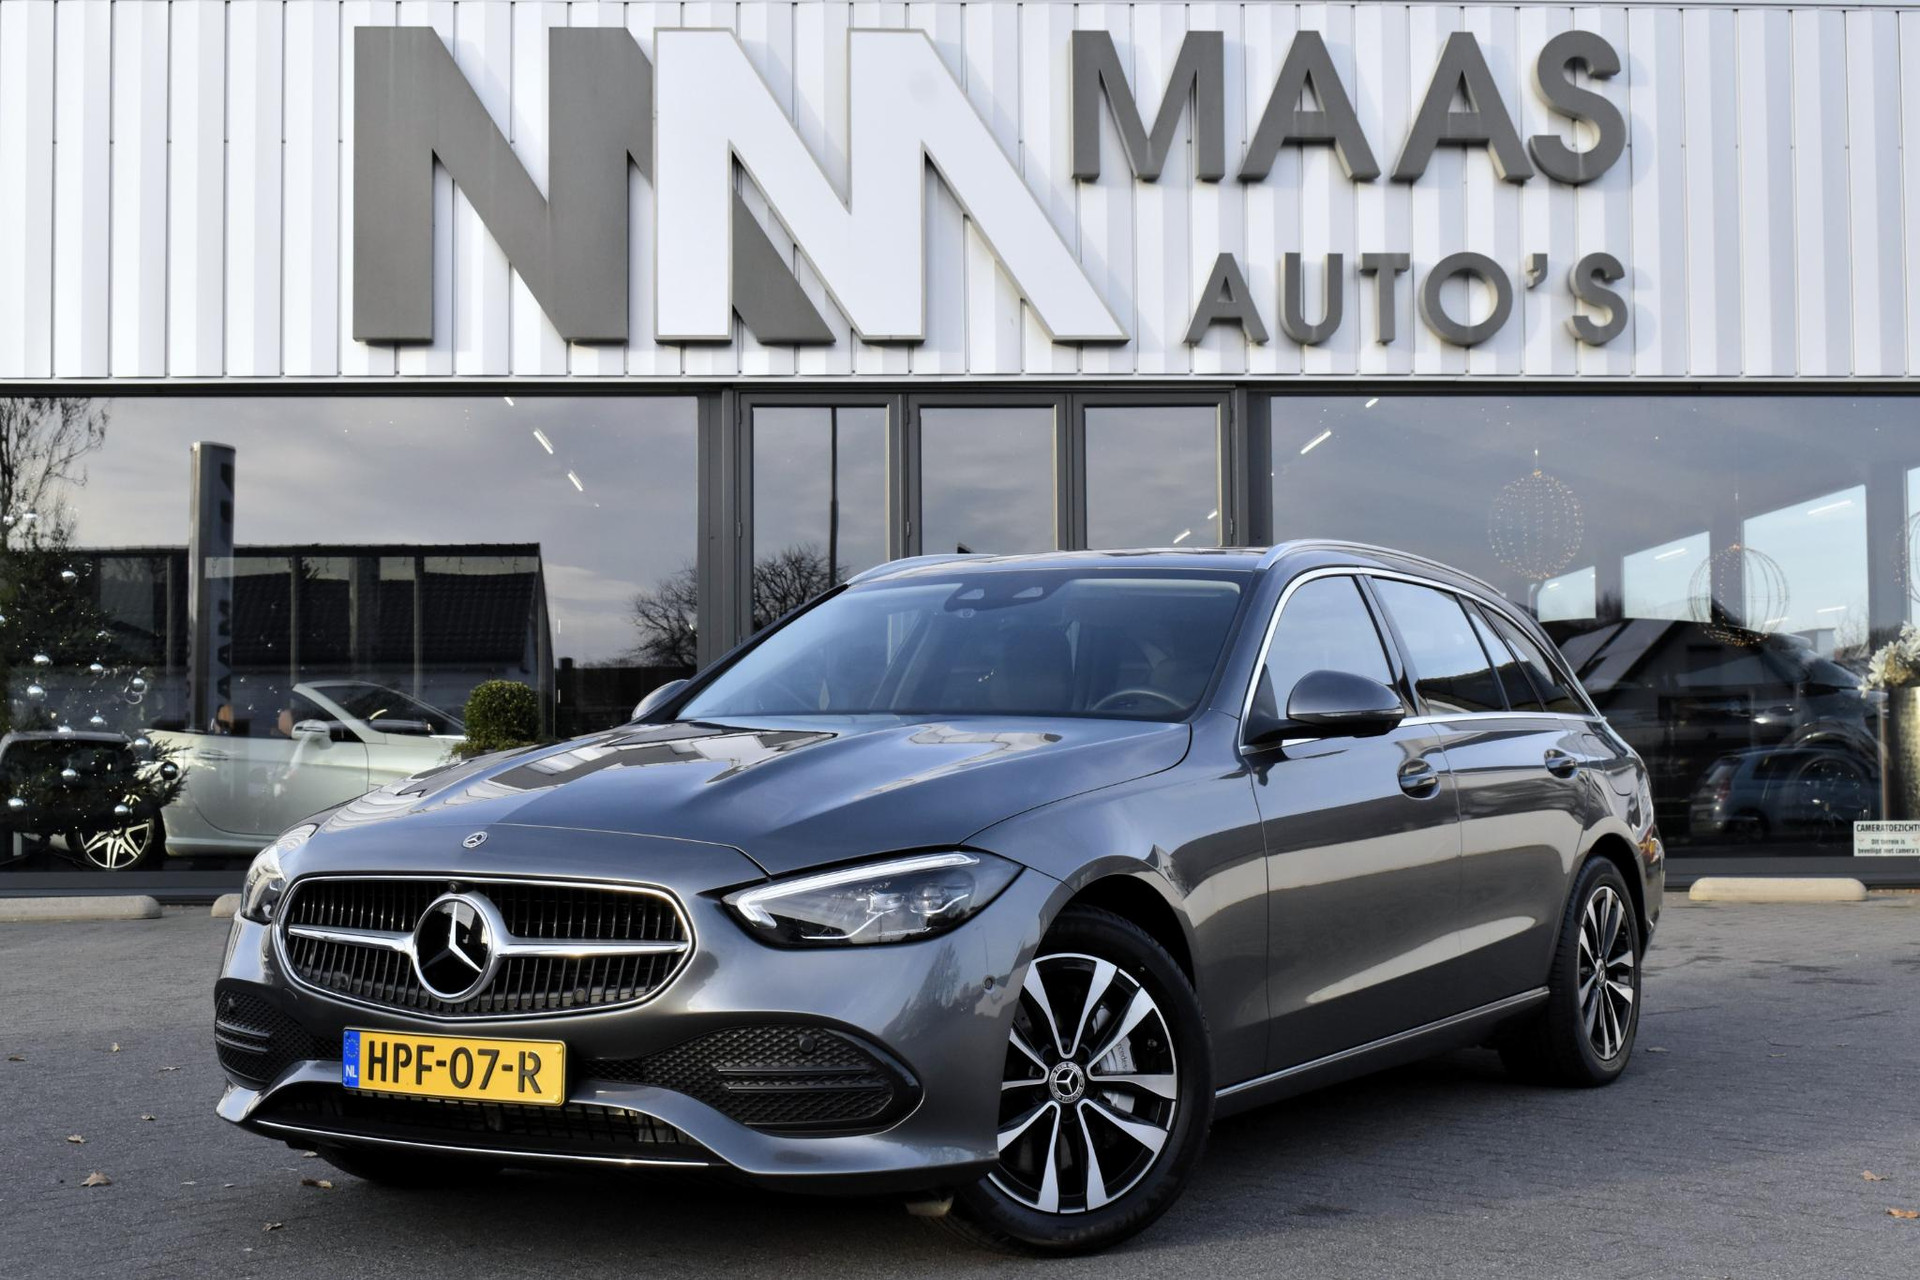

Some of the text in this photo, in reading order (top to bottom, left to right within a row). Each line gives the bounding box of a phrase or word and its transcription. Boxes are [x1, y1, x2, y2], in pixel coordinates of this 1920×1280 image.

[1072, 30, 1626, 185] MAAS
[1183, 252, 1628, 347] AUTO'S
[345, 1064, 358, 1078] NL
[367, 1040, 543, 1094] HPF-07-R
